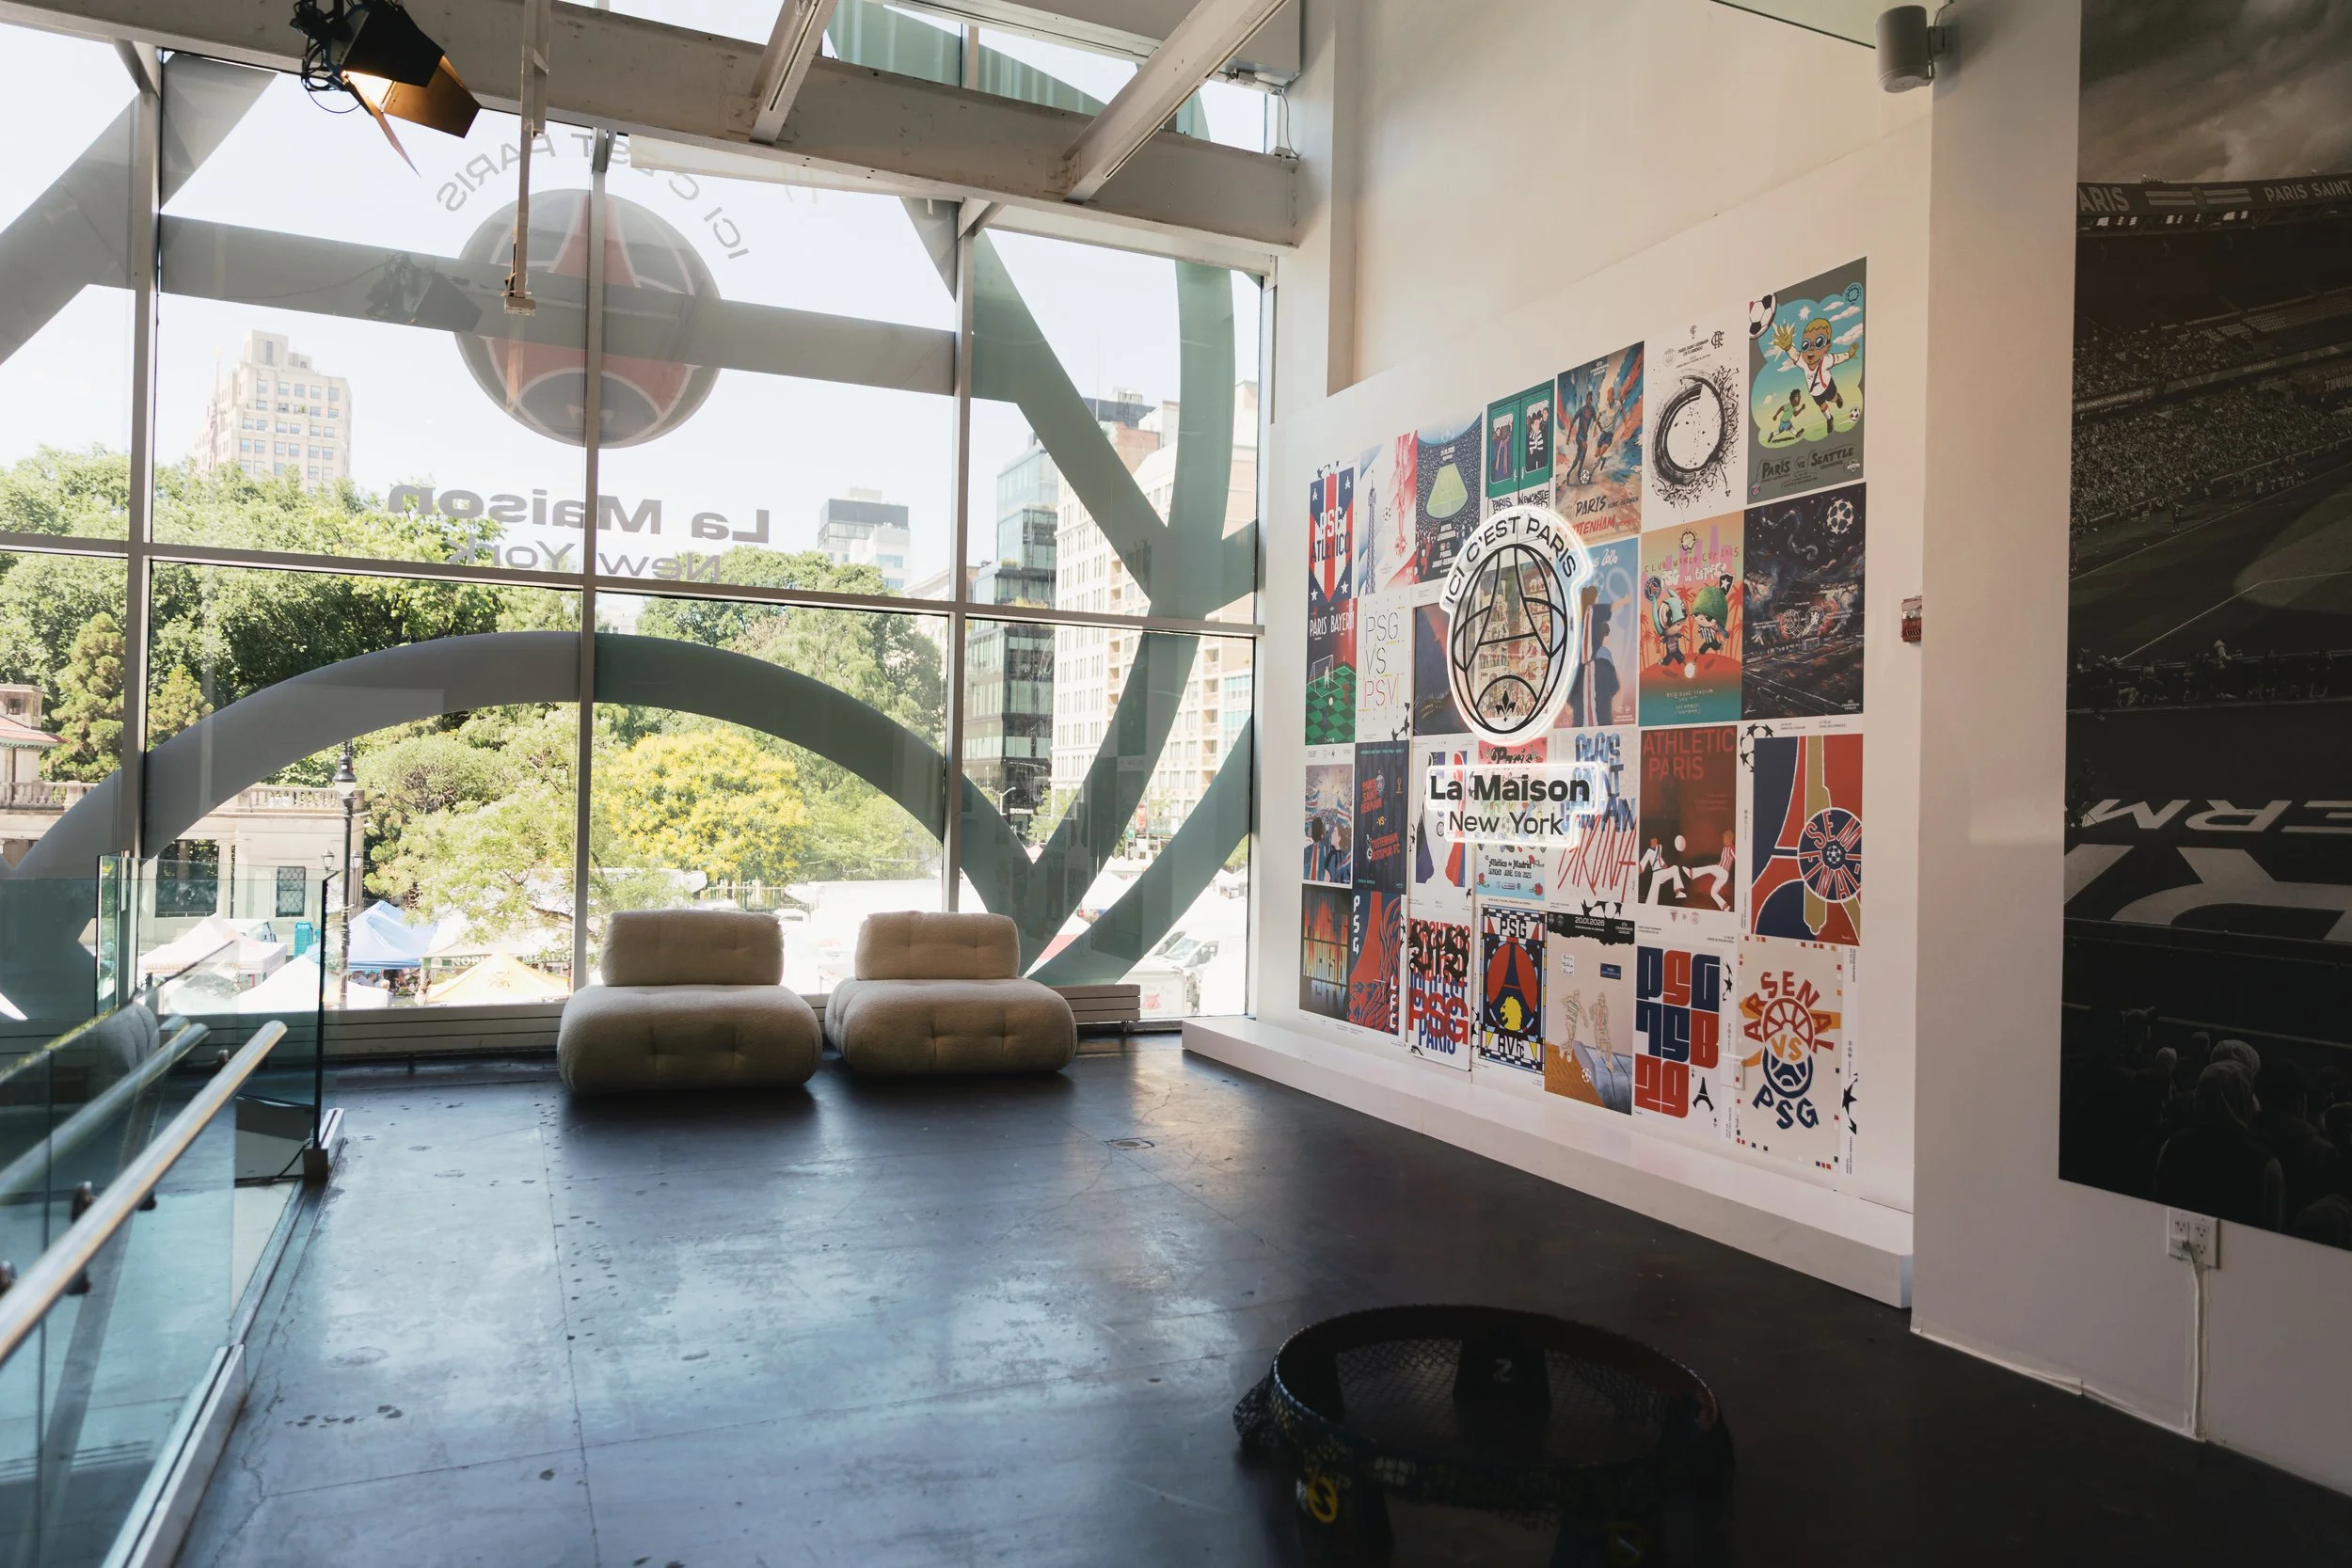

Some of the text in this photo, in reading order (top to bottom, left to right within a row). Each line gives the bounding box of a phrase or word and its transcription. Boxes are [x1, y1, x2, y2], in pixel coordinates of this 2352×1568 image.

[2263, 184, 2310, 203] PARIS
[1575, 495, 1607, 517] PARIS
[1444, 565, 1466, 604] ICI
[1466, 515, 1521, 563] C'EST
[1525, 516, 1577, 578] PARIS
[1309, 616, 1327, 638] PARIS
[1365, 611, 1399, 644] PSG
[1365, 646, 1387, 675] VS
[1364, 677, 1399, 708] PSV
[1642, 727, 1735, 758] ATHLETIC
[1648, 755, 1705, 782] PARIS
[1430, 775, 1463, 800] La
[1473, 774, 1590, 801] Maison
[1449, 811, 1565, 835] New York
[1352, 895, 1361, 956] PSG
[1500, 917, 1528, 939] PSG
[1407, 987, 1470, 1046] PSG
[1743, 970, 1835, 1054] ARSENAL
[1770, 1034, 1804, 1062] VS
[1752, 1083, 1820, 1131] PSG
